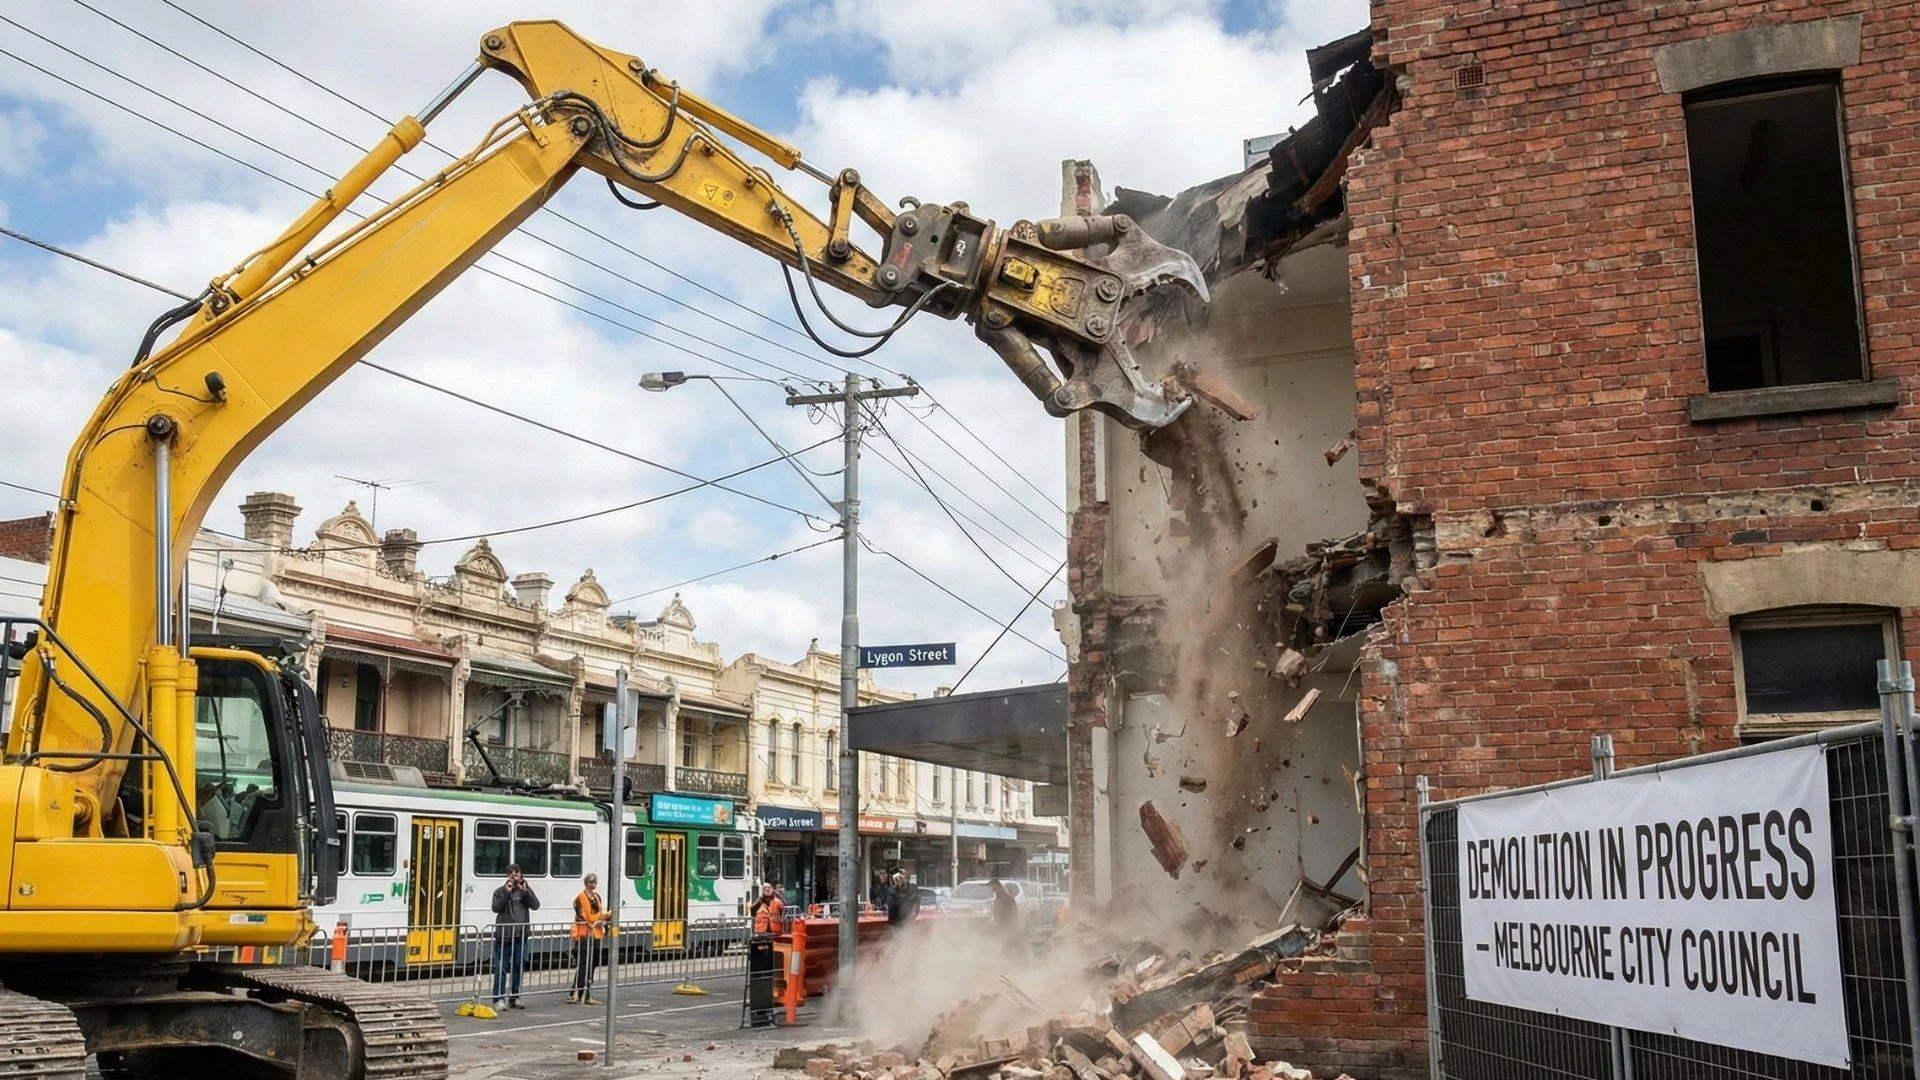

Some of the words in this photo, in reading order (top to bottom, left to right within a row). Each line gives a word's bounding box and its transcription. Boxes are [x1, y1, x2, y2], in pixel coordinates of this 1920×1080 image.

[867, 651, 903, 666] Lygon
[909, 648, 948, 661] Street
[1467, 829, 1592, 900] DEMOLITION
[1599, 827, 1627, 900] IN
[1636, 808, 1815, 900] PROGRESS
[1495, 922, 1614, 980] MELBOURNE
[1620, 927, 1673, 987] CITY
[1682, 928, 1816, 1004] COUNCIL
